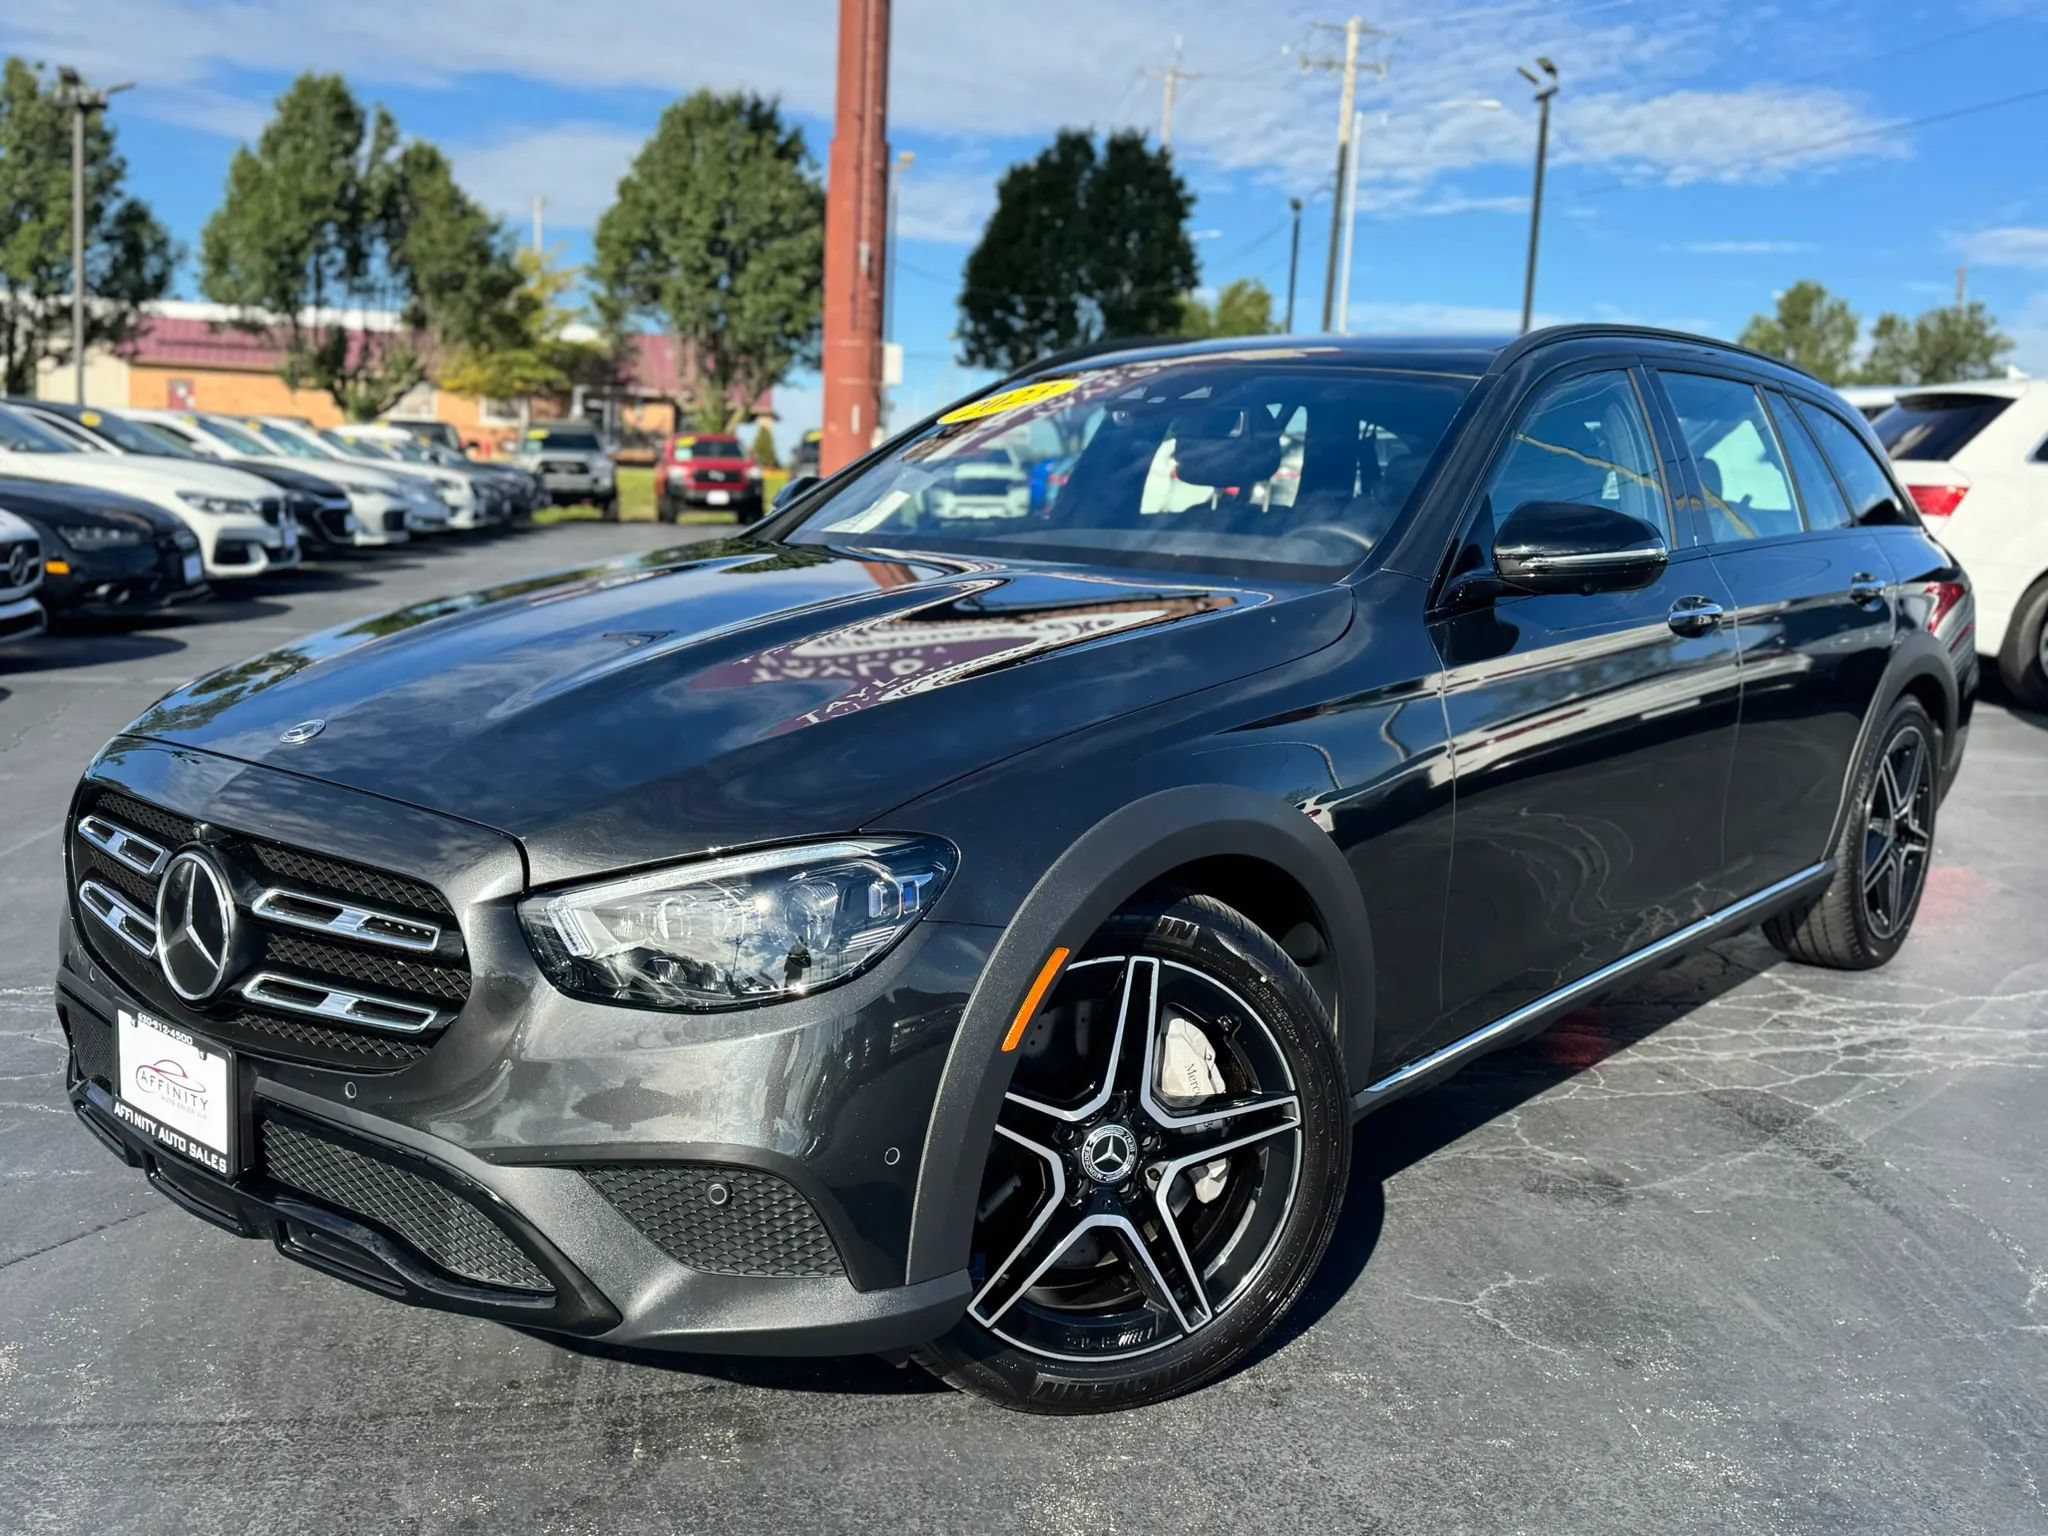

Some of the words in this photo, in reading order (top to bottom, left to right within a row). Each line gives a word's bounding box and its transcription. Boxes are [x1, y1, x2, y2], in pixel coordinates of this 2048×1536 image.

[141, 1070, 208, 1111] AFFINITY
[114, 1101, 157, 1136] AFFINITY
[158, 1127, 187, 1152] AUTO
[189, 1142, 227, 1174] SALES
